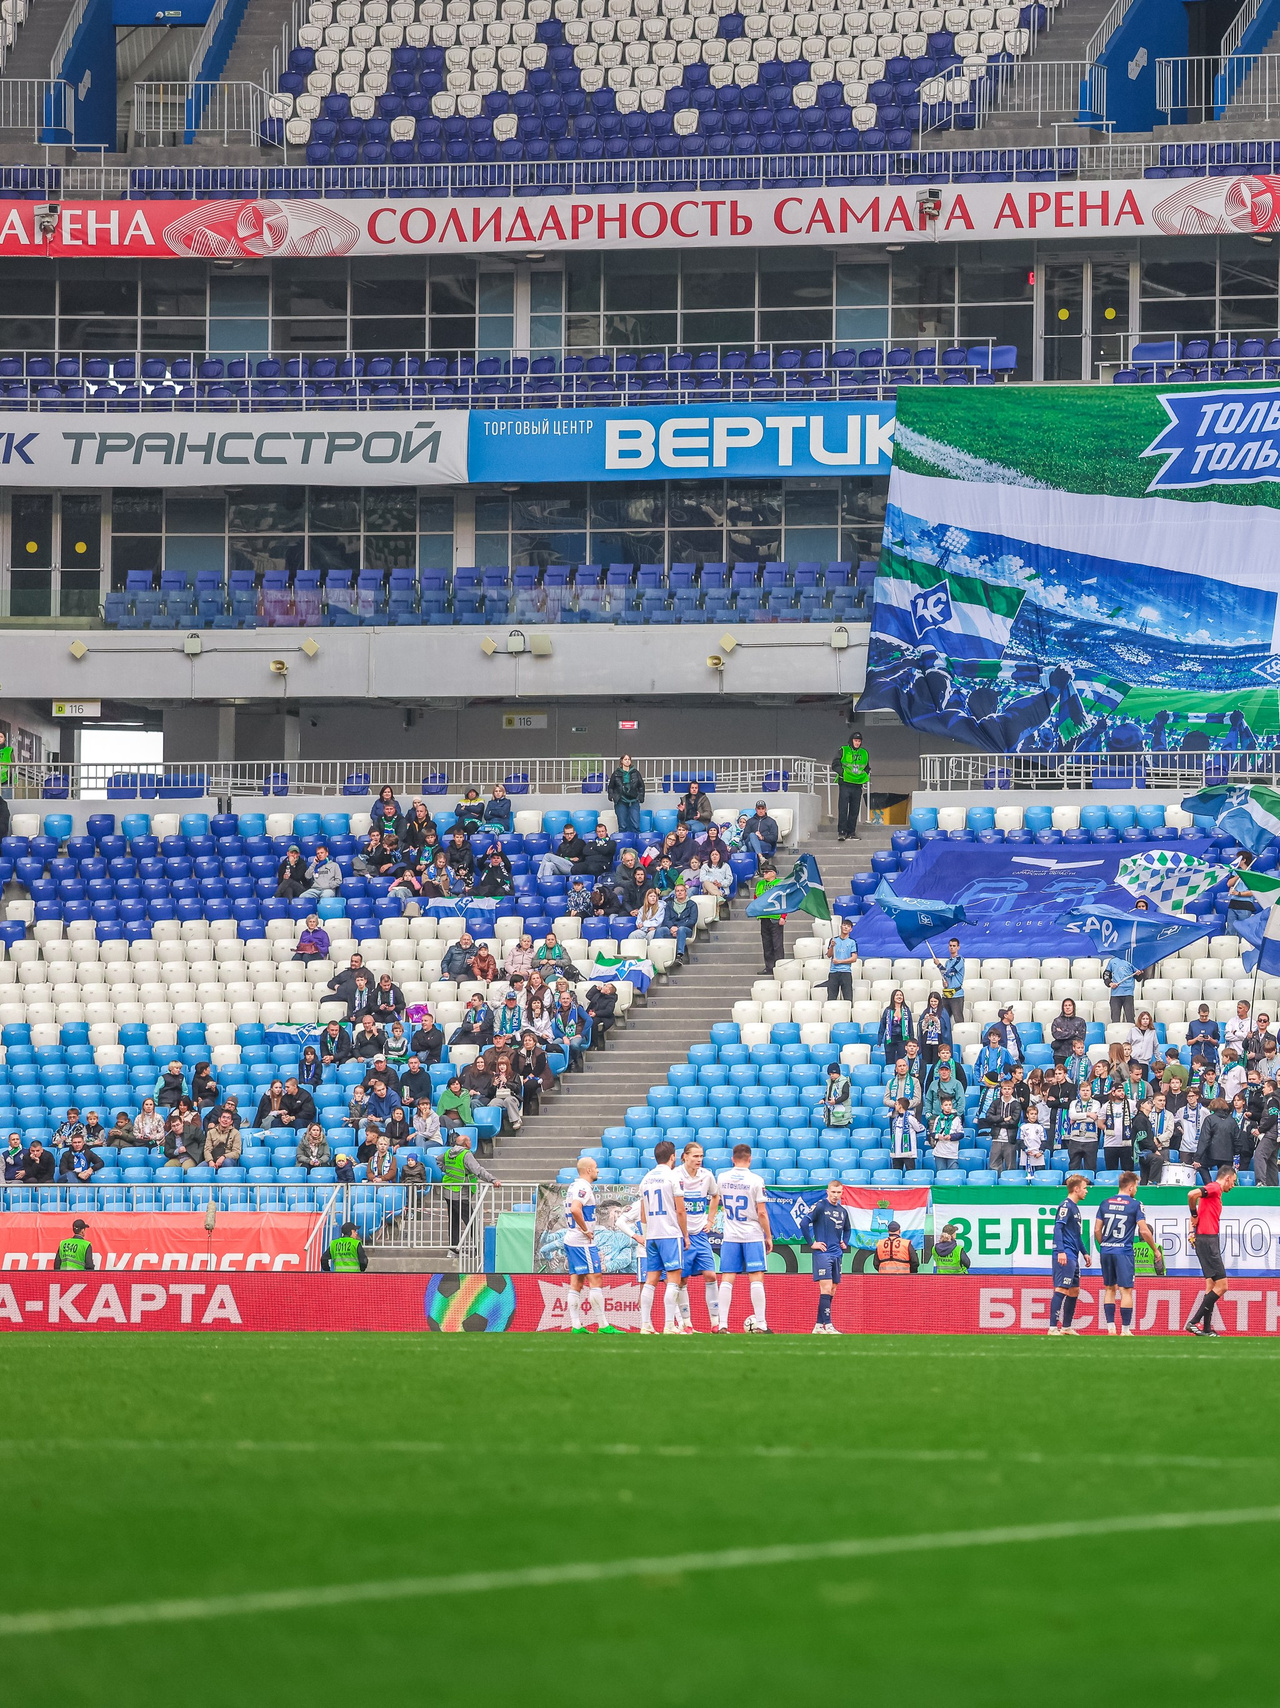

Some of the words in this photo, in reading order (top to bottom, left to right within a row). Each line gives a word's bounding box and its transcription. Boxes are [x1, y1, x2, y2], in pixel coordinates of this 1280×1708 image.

[367, 199, 753, 246] СОЛИДАРНОСТЬ
[994, 188, 1146, 230] АРЕНА
[484, 419, 549, 436] ТОРГОВЫЙ
[553, 418, 593, 434] ЦЕНТР
[0, 432, 40, 465] К
[62, 421, 442, 465] ТРАНССТРОЙ
[69, 704, 84, 714] 116
[518, 717, 532, 726] 116
[644, 1188, 668, 1216] 11
[722, 1194, 749, 1222] 52
[1102, 1214, 1128, 1238] 73
